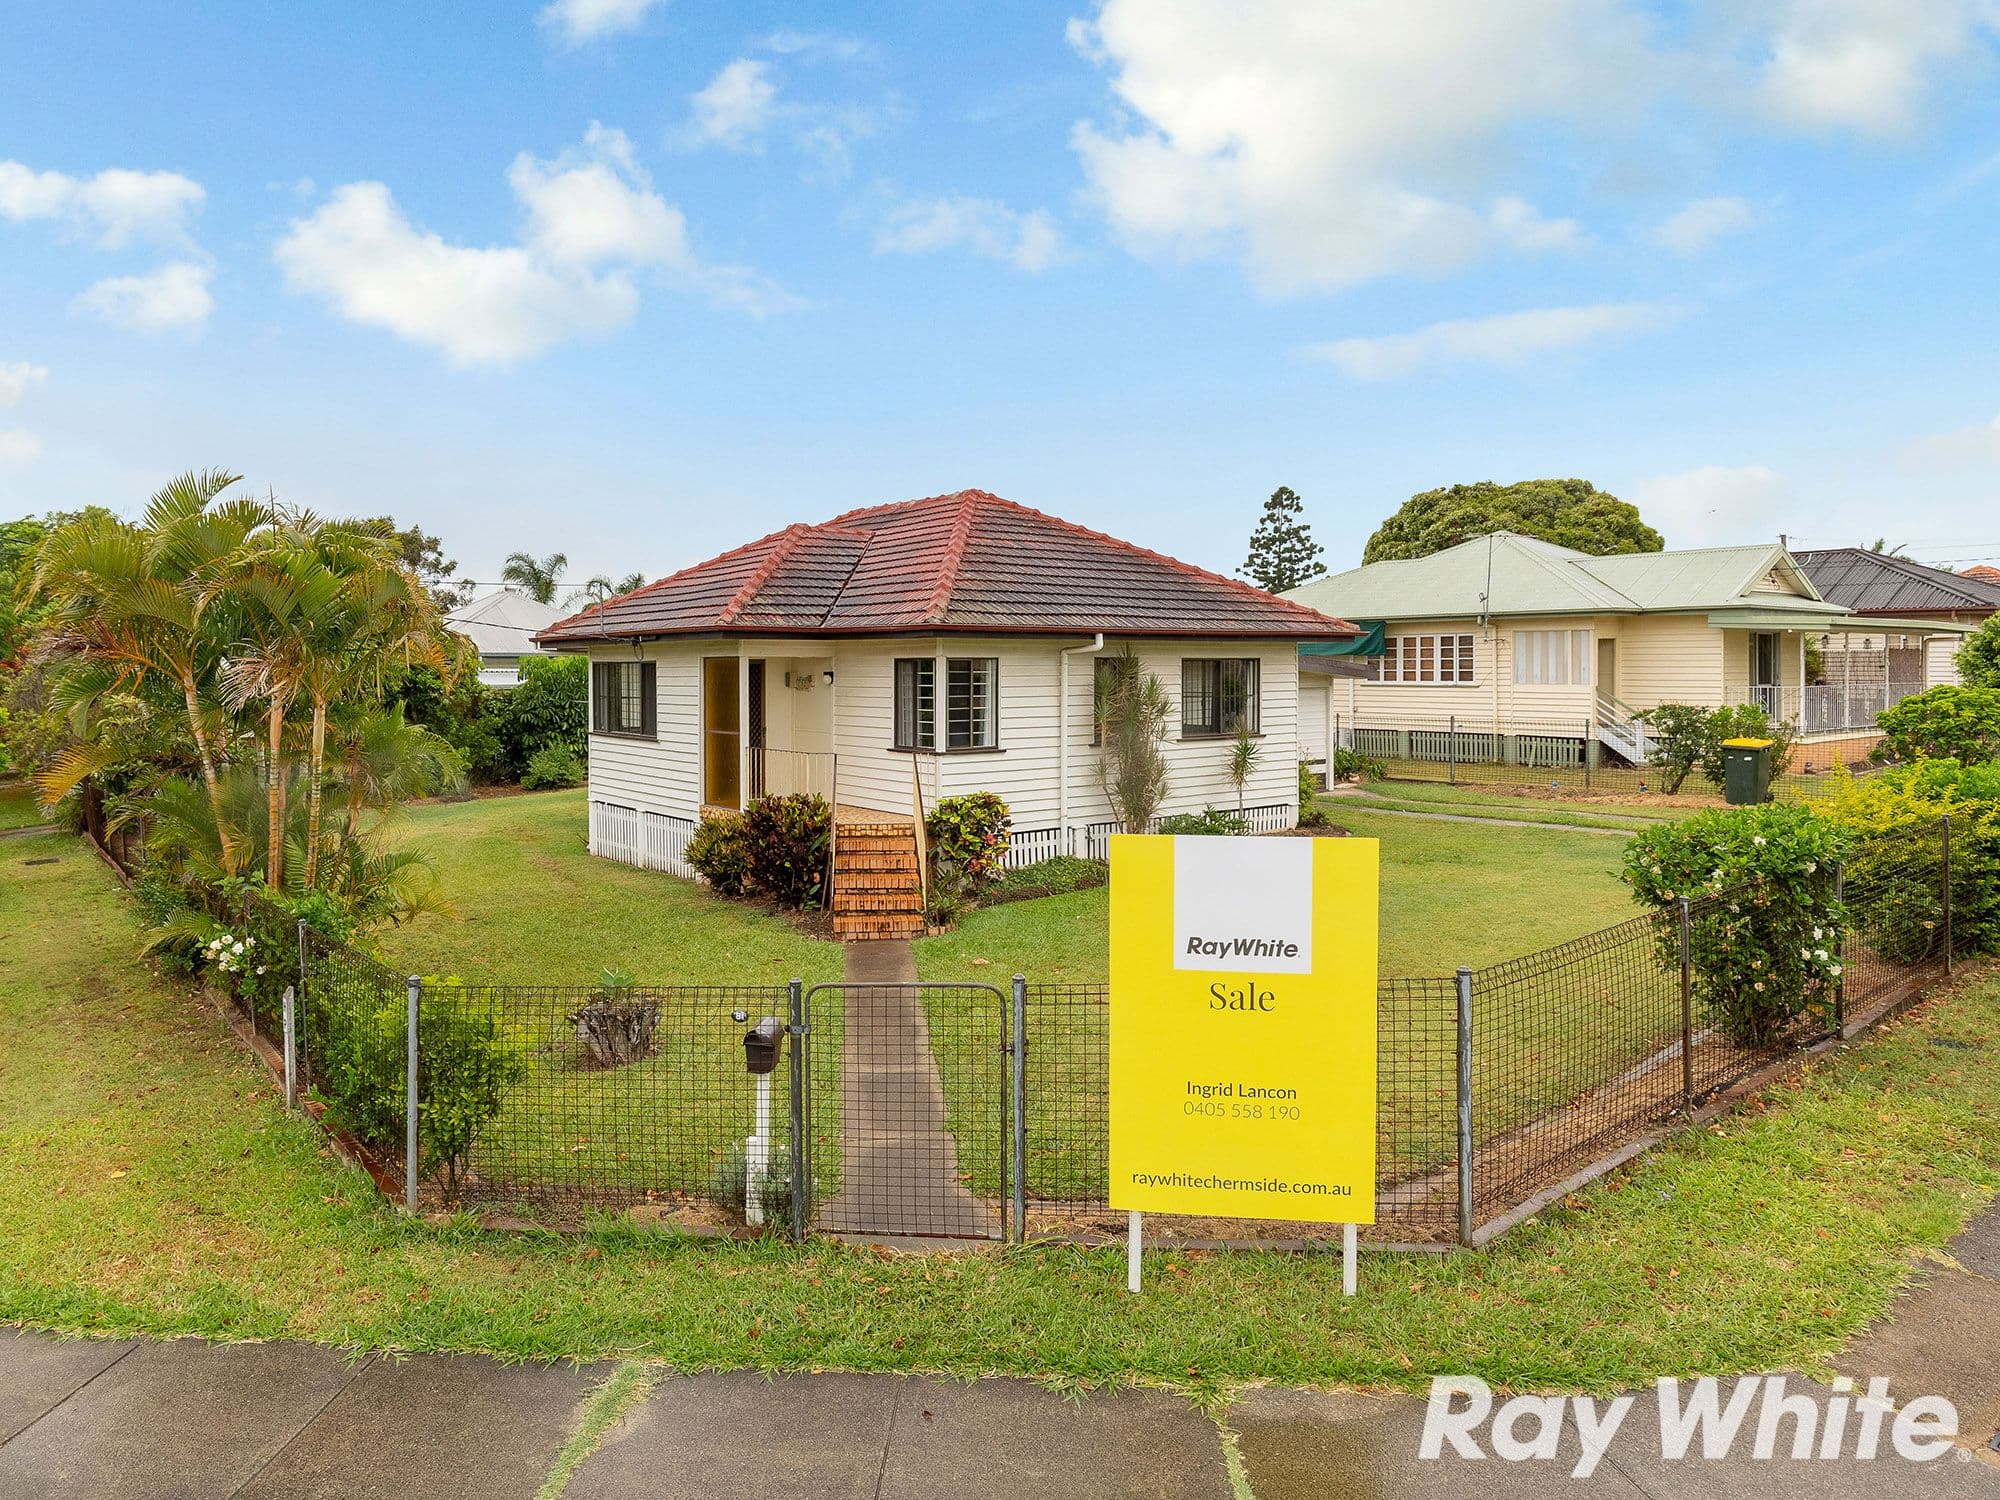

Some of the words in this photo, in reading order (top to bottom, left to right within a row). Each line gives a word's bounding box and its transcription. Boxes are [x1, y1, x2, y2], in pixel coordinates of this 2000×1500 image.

[1209, 982, 1276, 1012] Sale
[1186, 1081, 1233, 1099] Ingrid
[1238, 1083, 1297, 1099] Lancon
[1183, 1101, 1226, 1117] 0405
[1231, 1103, 1263, 1119] 558
[1268, 1104, 1300, 1121] 190
[1132, 1173, 1352, 1196] raywhitechermside.com.au
